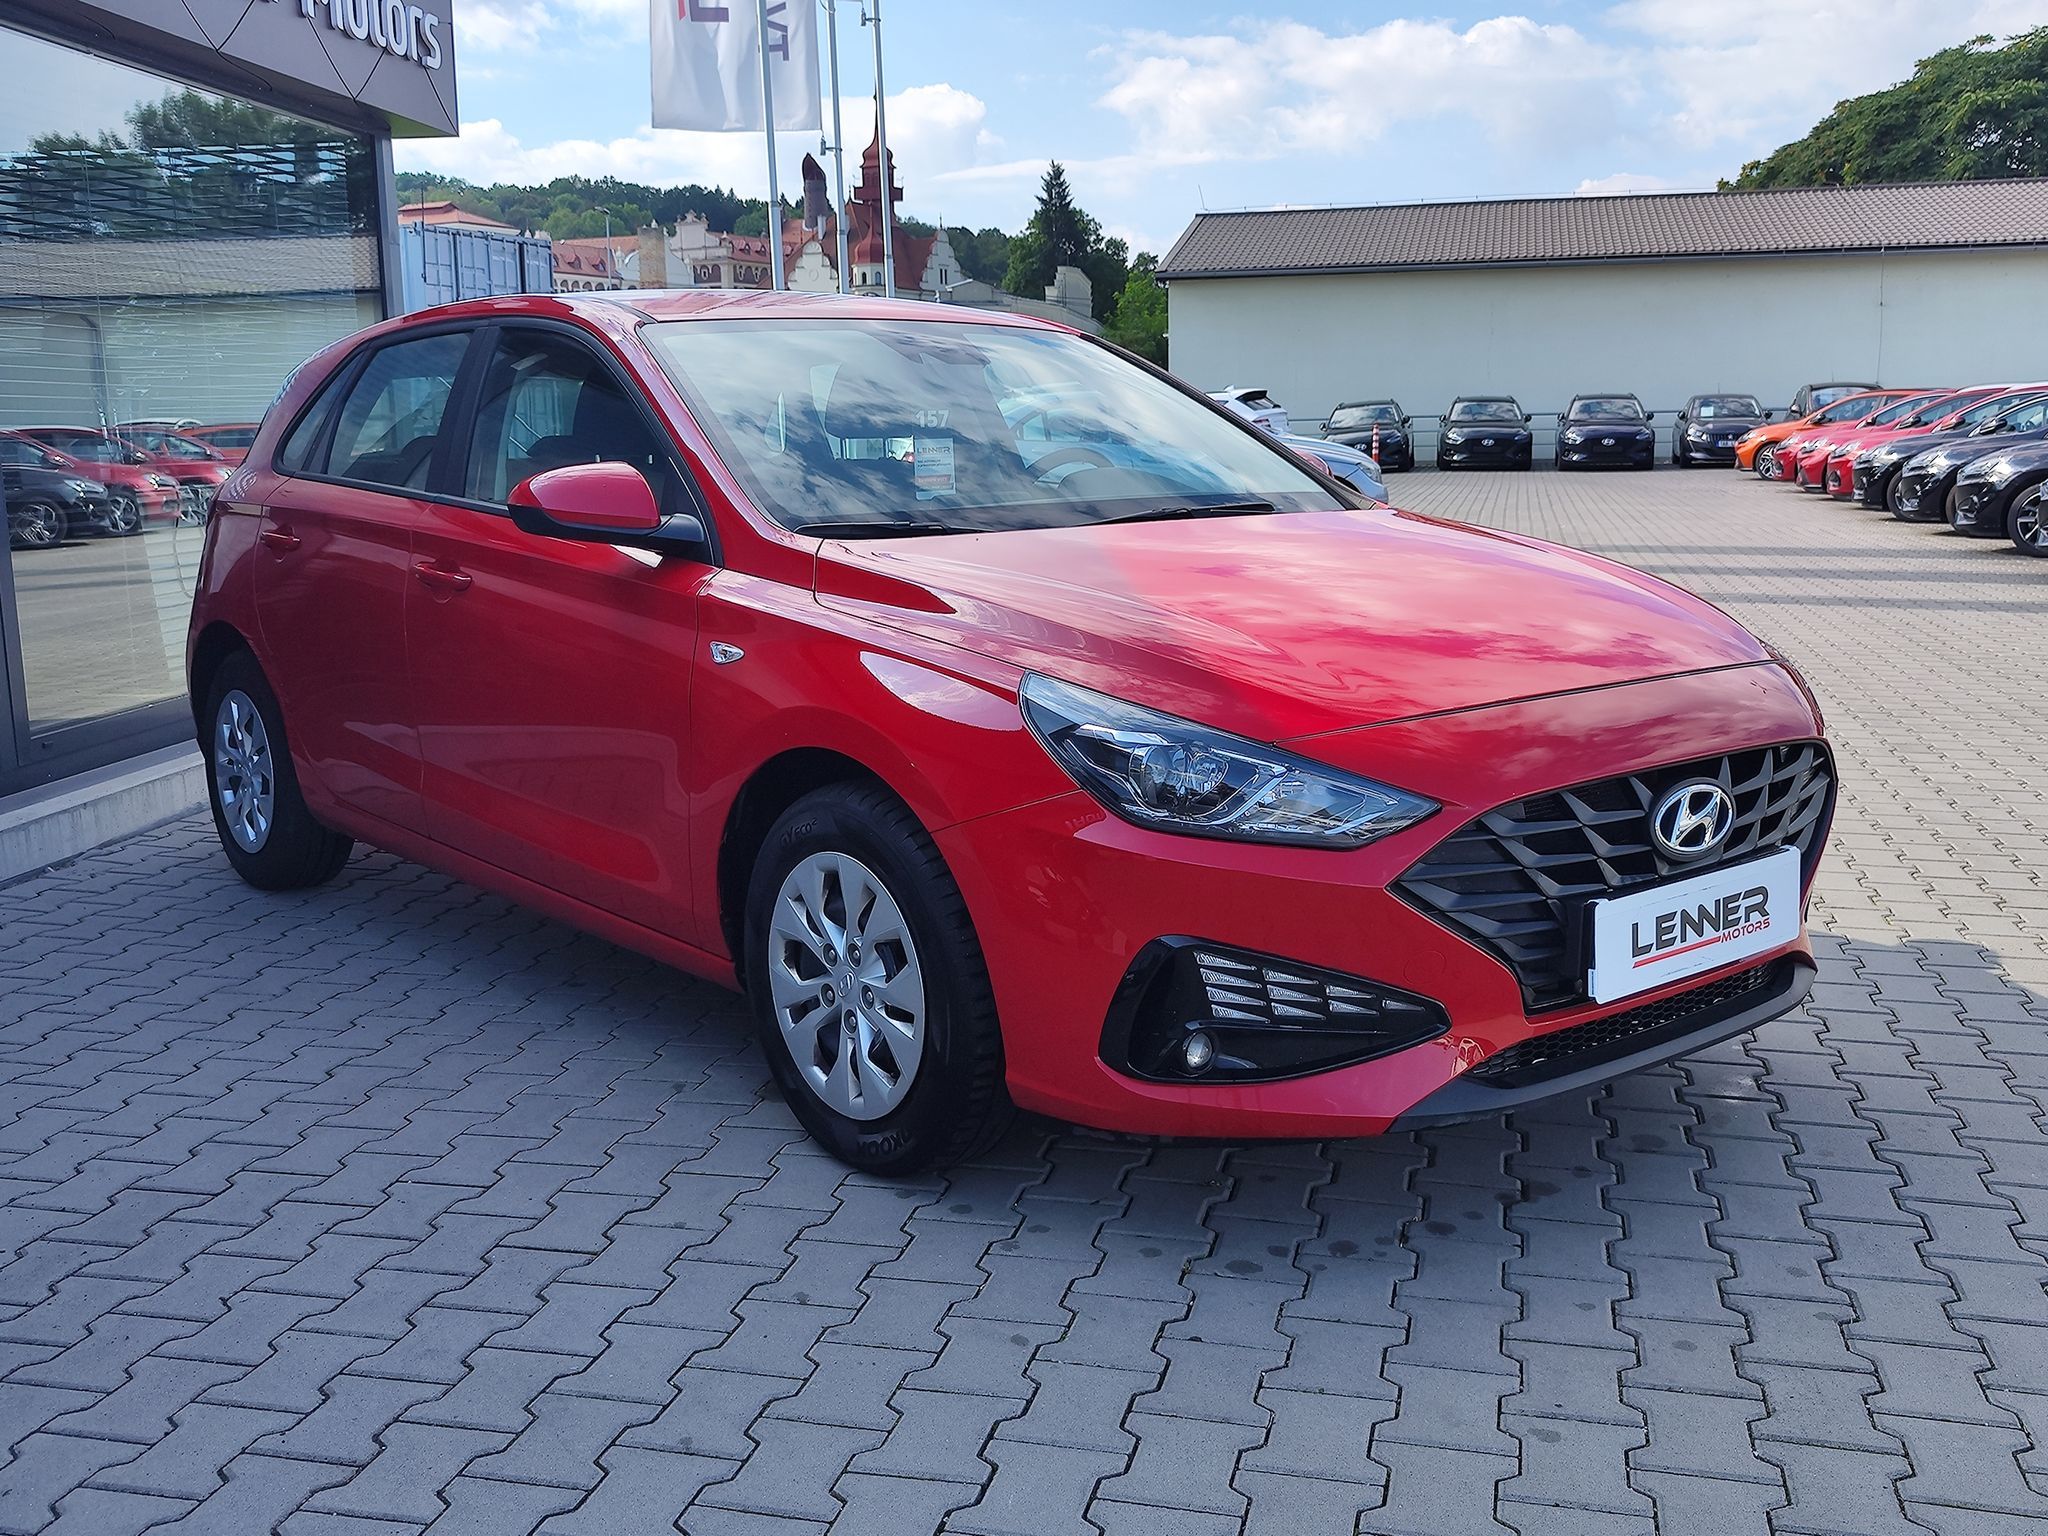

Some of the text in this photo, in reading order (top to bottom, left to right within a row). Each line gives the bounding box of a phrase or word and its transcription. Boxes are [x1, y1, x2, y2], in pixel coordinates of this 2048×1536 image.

[916, 409, 949, 428] 157
[1632, 886, 1770, 958] LENNER
[1721, 917, 1771, 943] MOTORS
